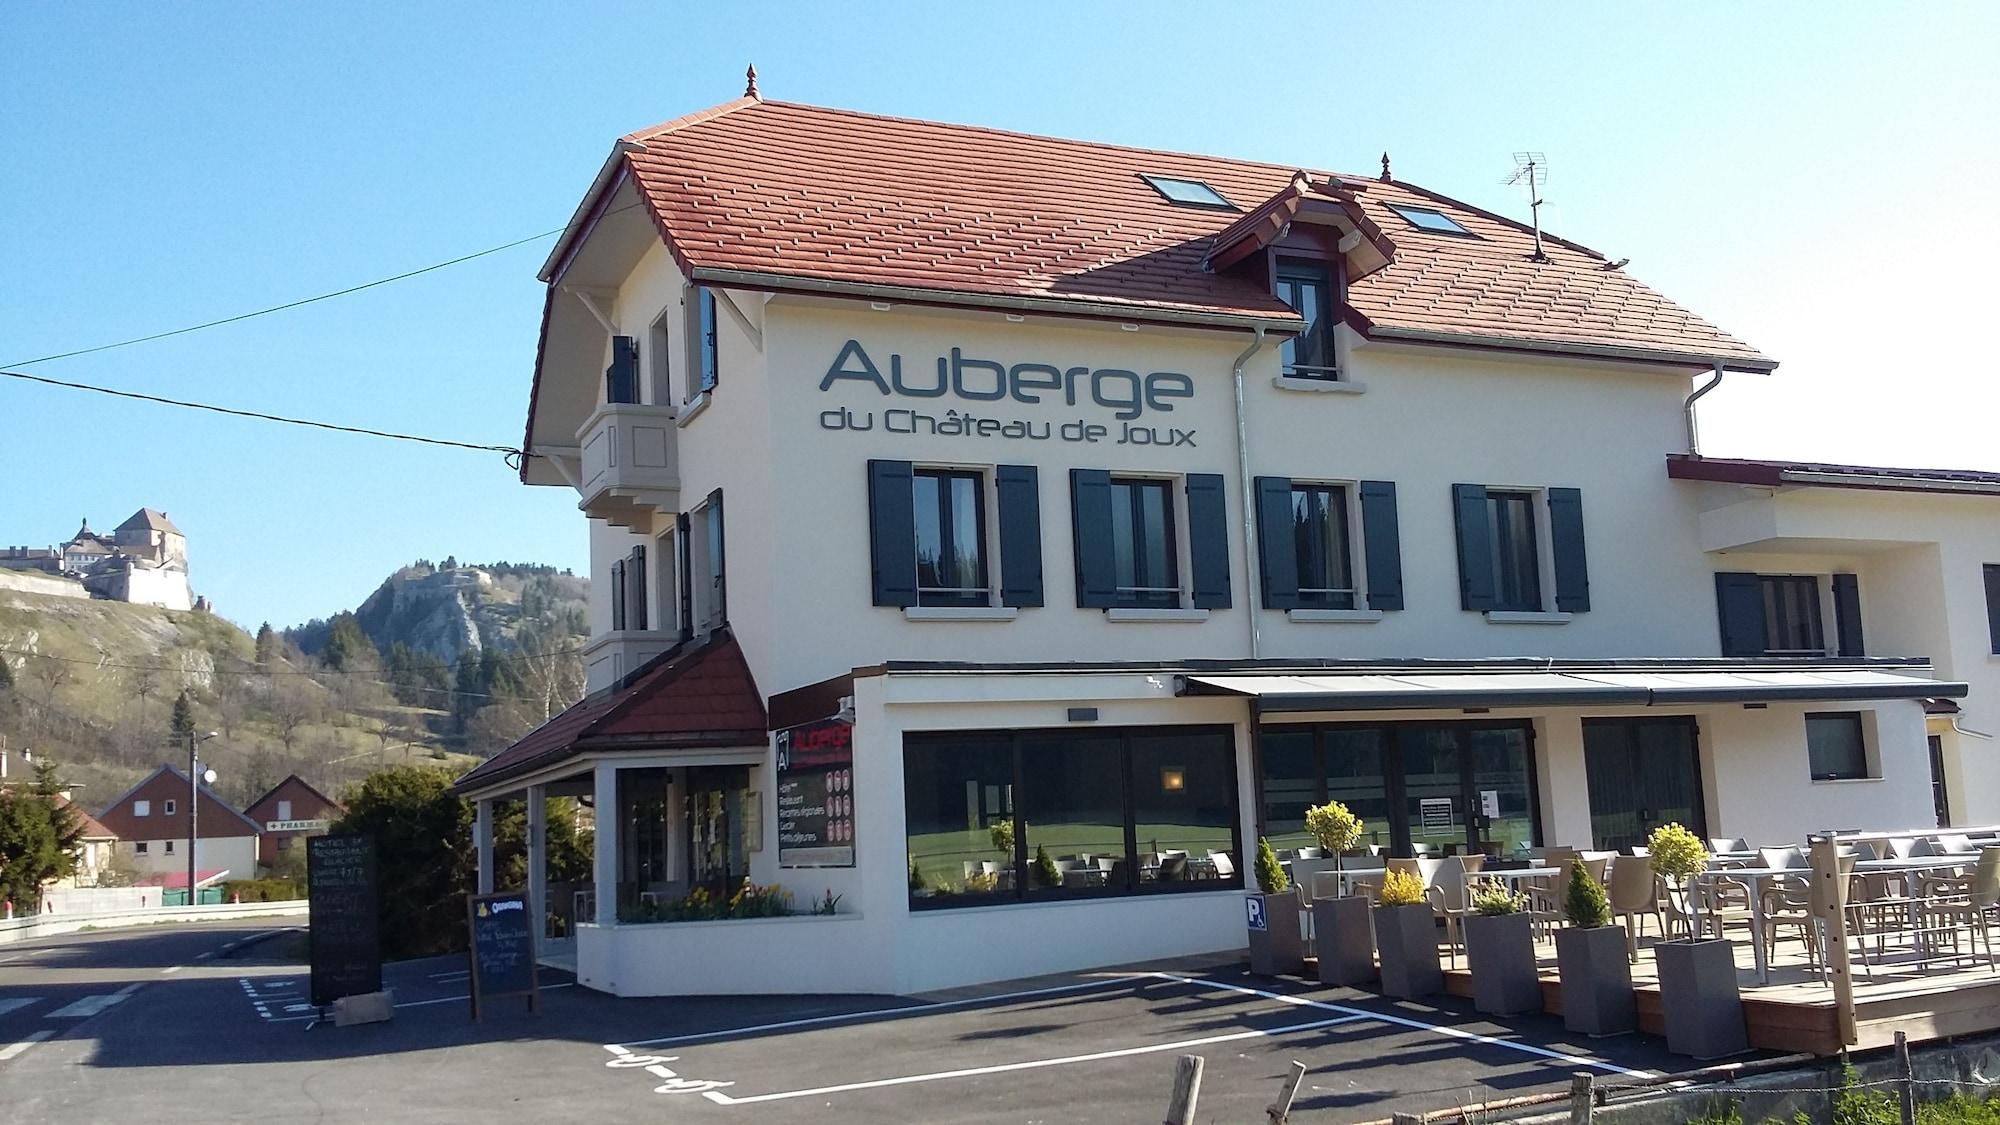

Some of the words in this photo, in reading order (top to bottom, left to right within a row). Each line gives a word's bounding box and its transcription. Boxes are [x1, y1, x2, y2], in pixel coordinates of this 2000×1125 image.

[819, 339, 1194, 420] Auberge
[820, 406, 873, 431] du
[884, 409, 1051, 440] Château
[1061, 419, 1107, 442] de
[1117, 421, 1197, 447] Joux
[1247, 899, 1260, 922] P
